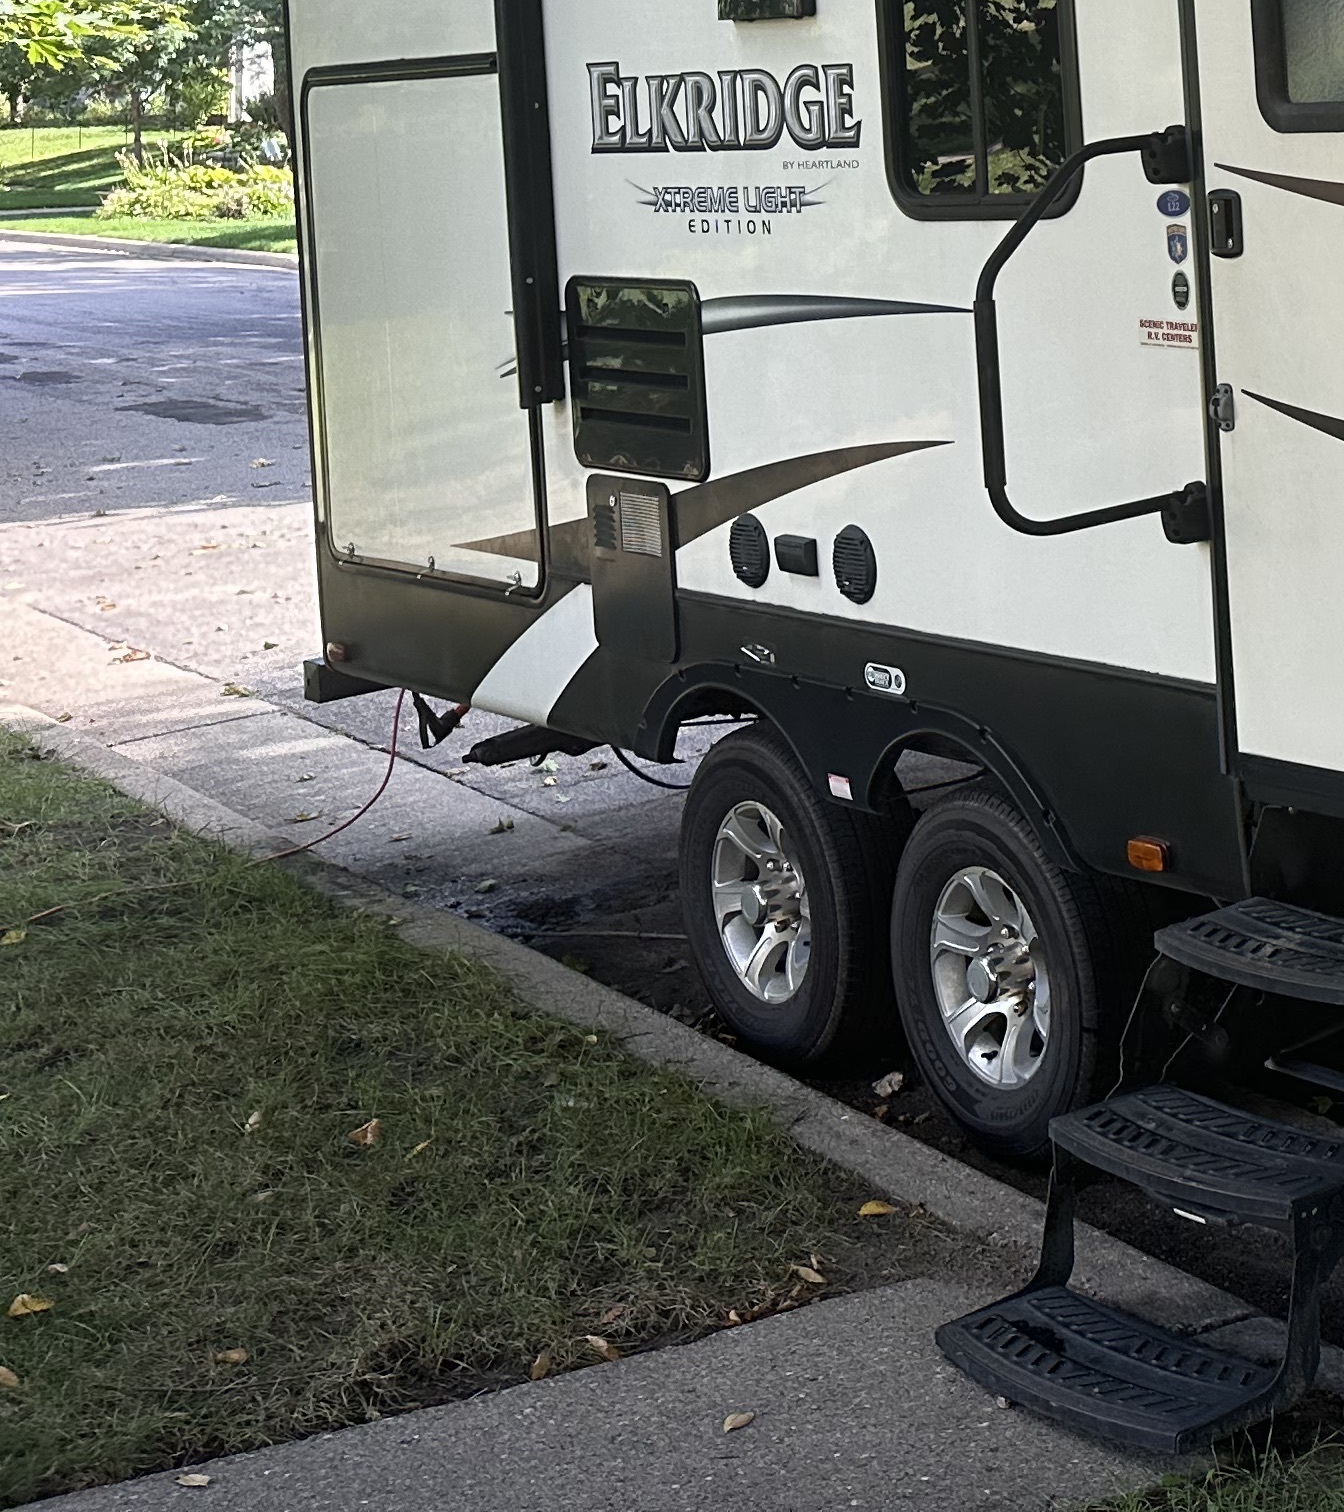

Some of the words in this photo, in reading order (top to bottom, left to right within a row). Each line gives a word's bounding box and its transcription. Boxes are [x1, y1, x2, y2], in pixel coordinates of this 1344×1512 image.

[782, 160, 795, 170] BY
[797, 159, 860, 170] HEARTLAND
[652, 186, 739, 213] XTREME
[743, 186, 806, 213] LIGHT
[688, 219, 772, 235] EDITION
[1161, 332, 1193, 344] CENTERS
